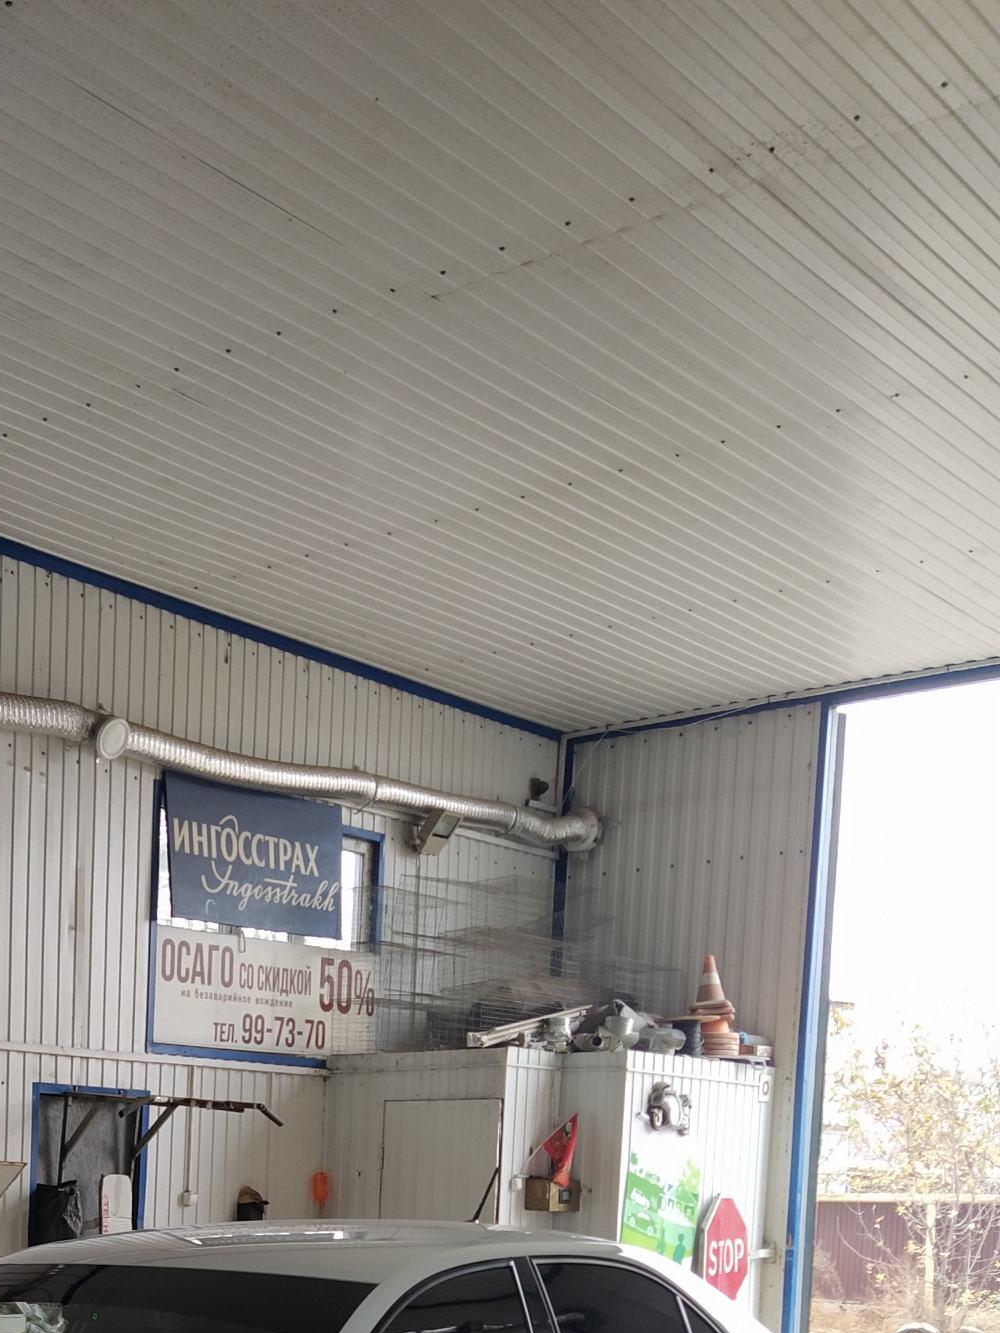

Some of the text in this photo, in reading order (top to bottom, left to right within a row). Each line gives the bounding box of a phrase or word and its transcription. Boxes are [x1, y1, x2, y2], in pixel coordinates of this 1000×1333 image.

[173, 815, 320, 878] ИНГОССТРАХ
[201, 860, 340, 912] Ingosstrakh
[161, 938, 234, 988] ОСАГО
[257, 964, 312, 998] СКИДКОЙ
[319, 956, 375, 1017] 50%
[213, 1013, 326, 1050] ТЕЛ. 99-73-70
[708, 1238, 744, 1277] STOP
